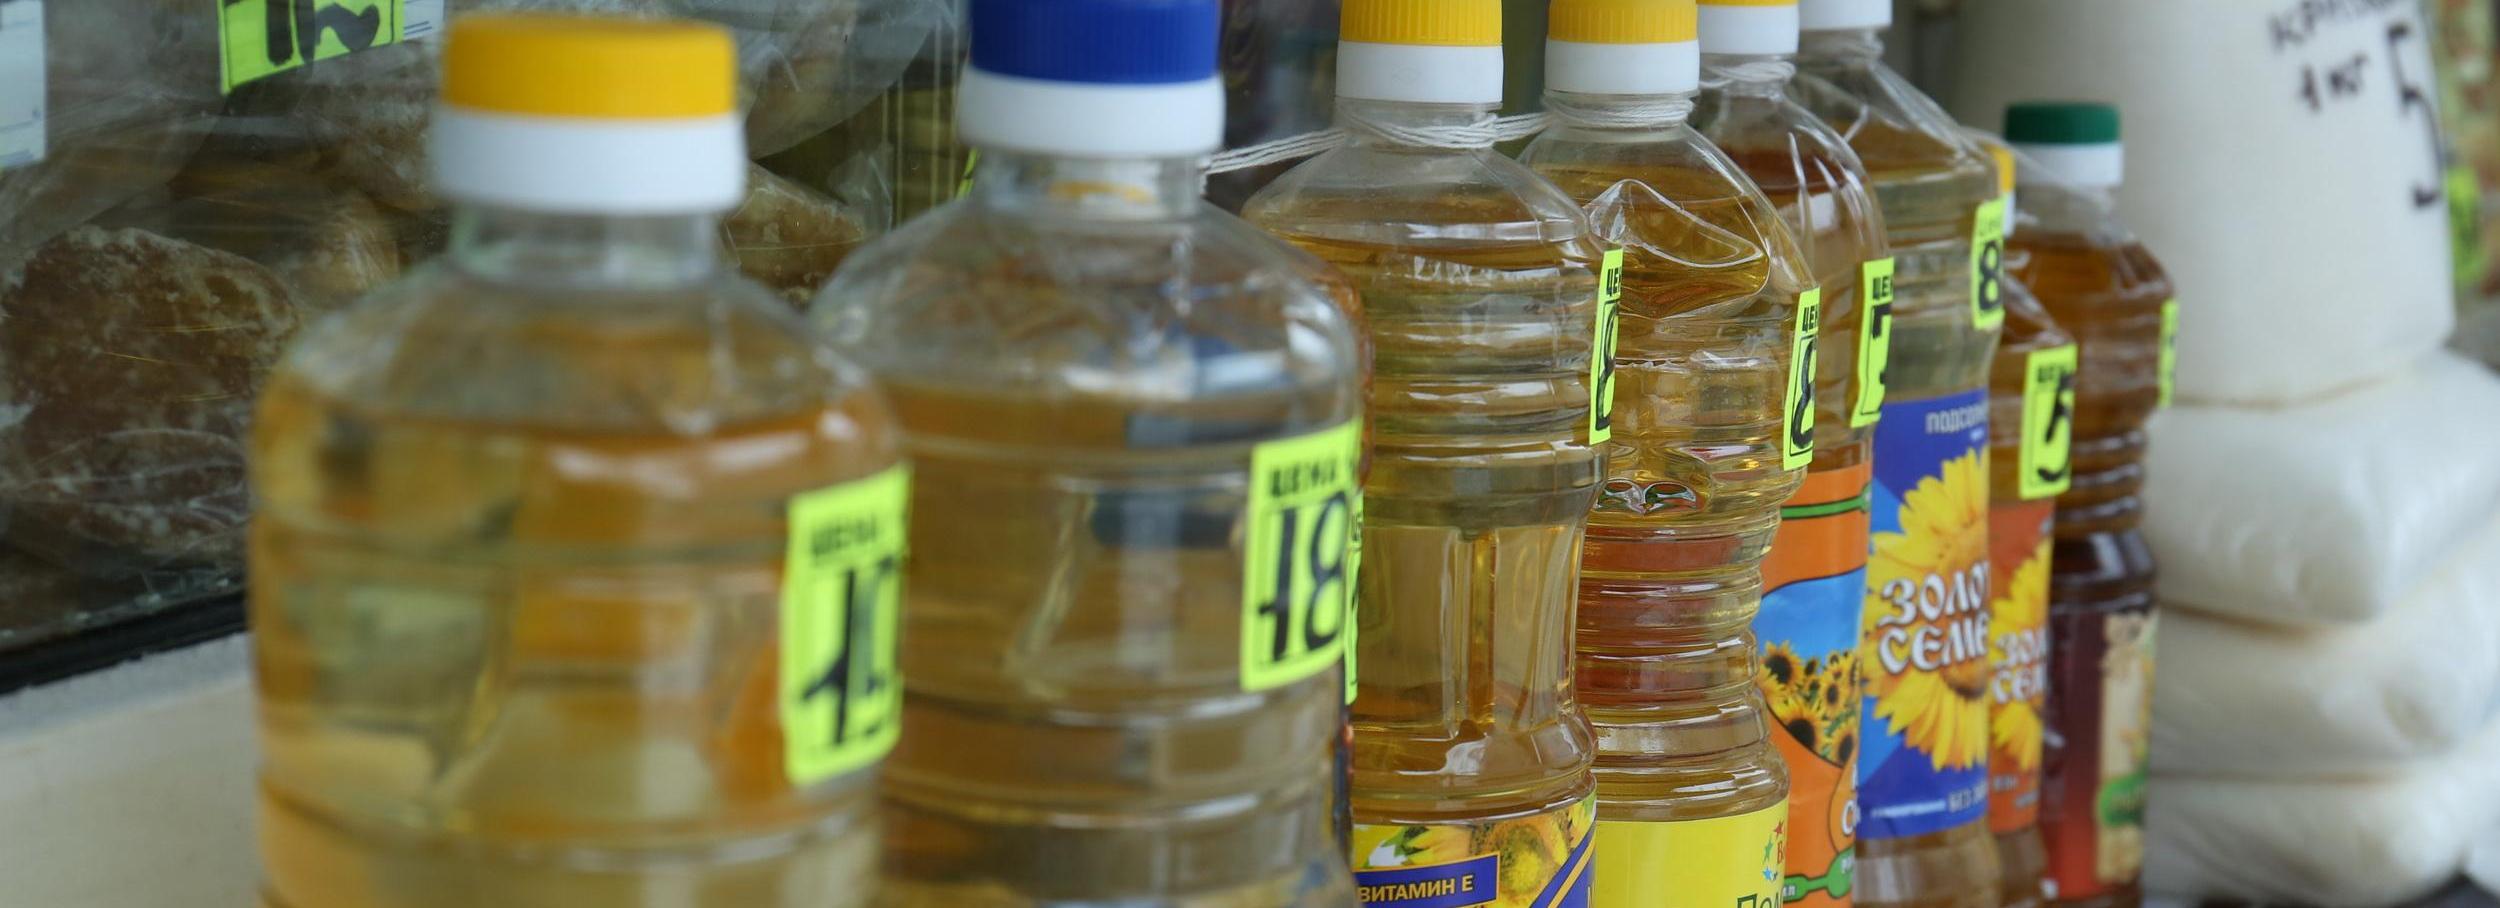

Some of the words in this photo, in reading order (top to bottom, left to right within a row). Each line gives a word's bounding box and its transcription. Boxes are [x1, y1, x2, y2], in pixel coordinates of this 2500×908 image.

[1605, 268, 1622, 296] ЦЕ
[1258, 488, 1347, 662] 18
[1358, 877, 1455, 903] ВИТАМИН
